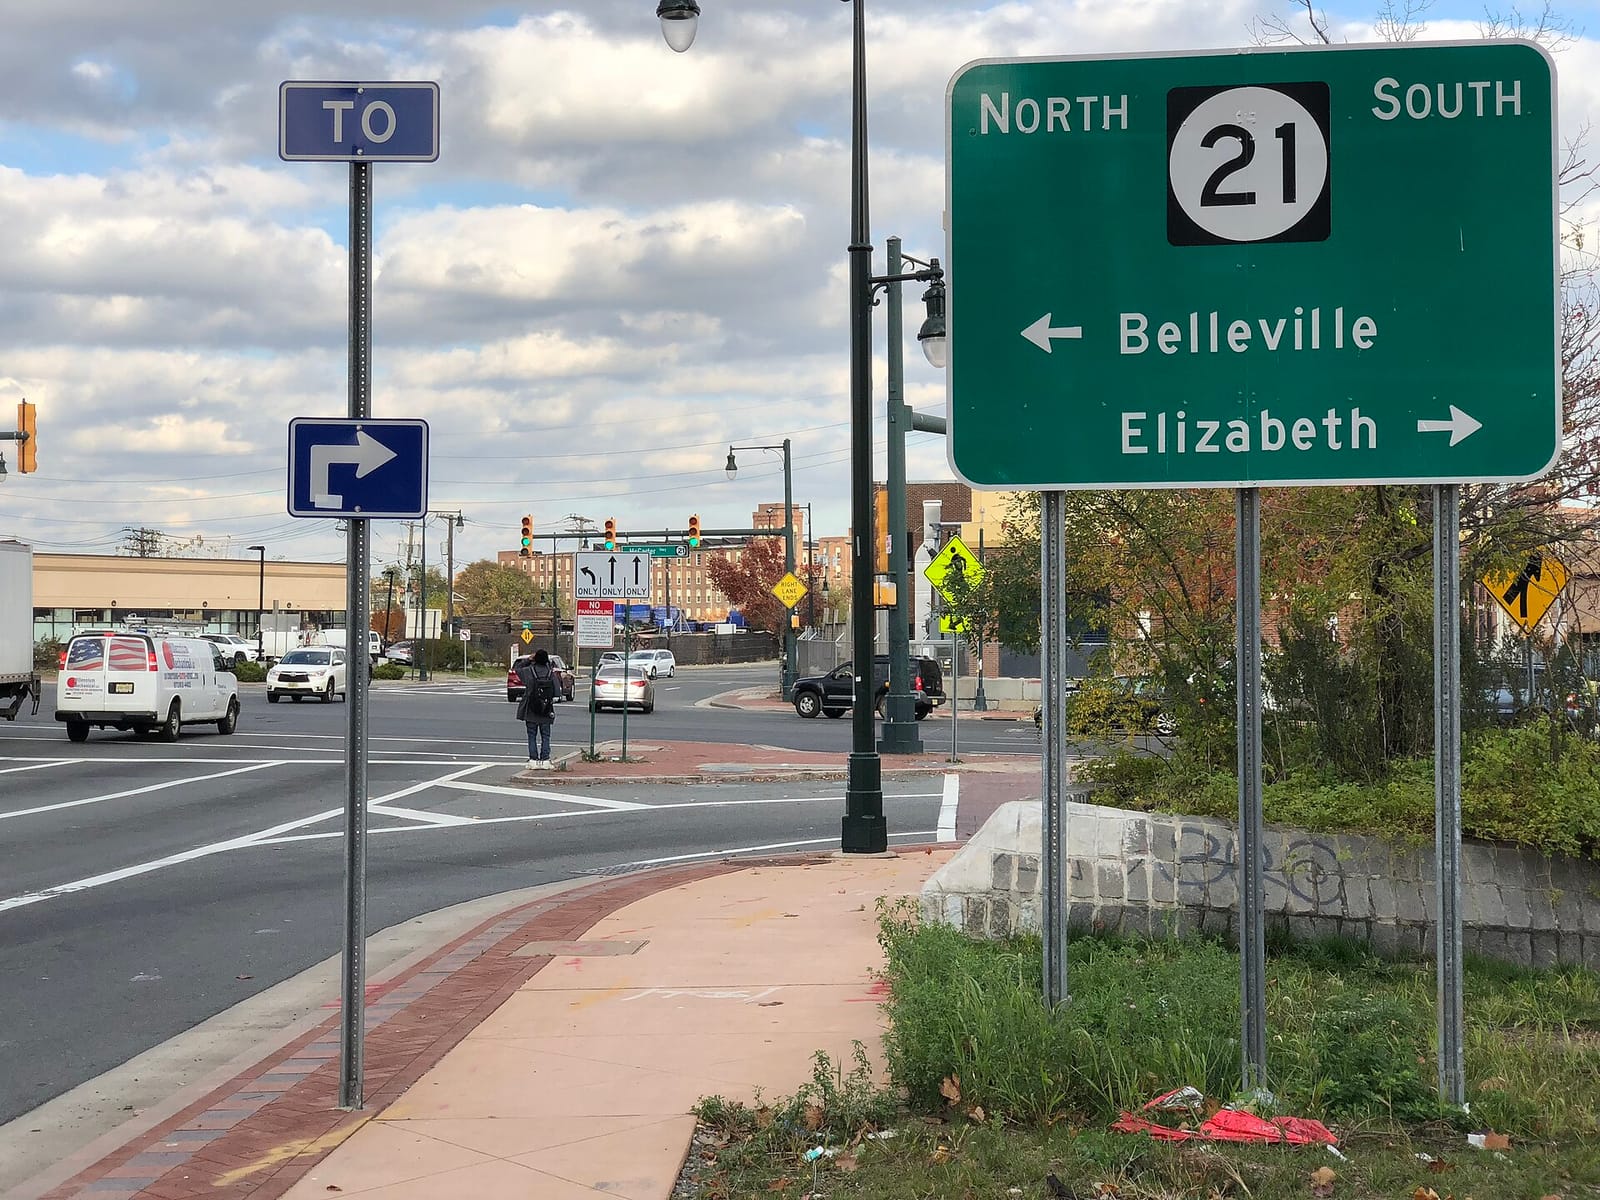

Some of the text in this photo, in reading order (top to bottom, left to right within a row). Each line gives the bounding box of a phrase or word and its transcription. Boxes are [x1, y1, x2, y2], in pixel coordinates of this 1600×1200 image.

[322, 100, 397, 143] TO
[980, 92, 1128, 135] NORTH
[1371, 77, 1521, 121] SOUTH
[1200, 122, 1297, 207] 21
[1120, 306, 1378, 354] Belleville
[1121, 407, 1377, 454] Elizabeth
